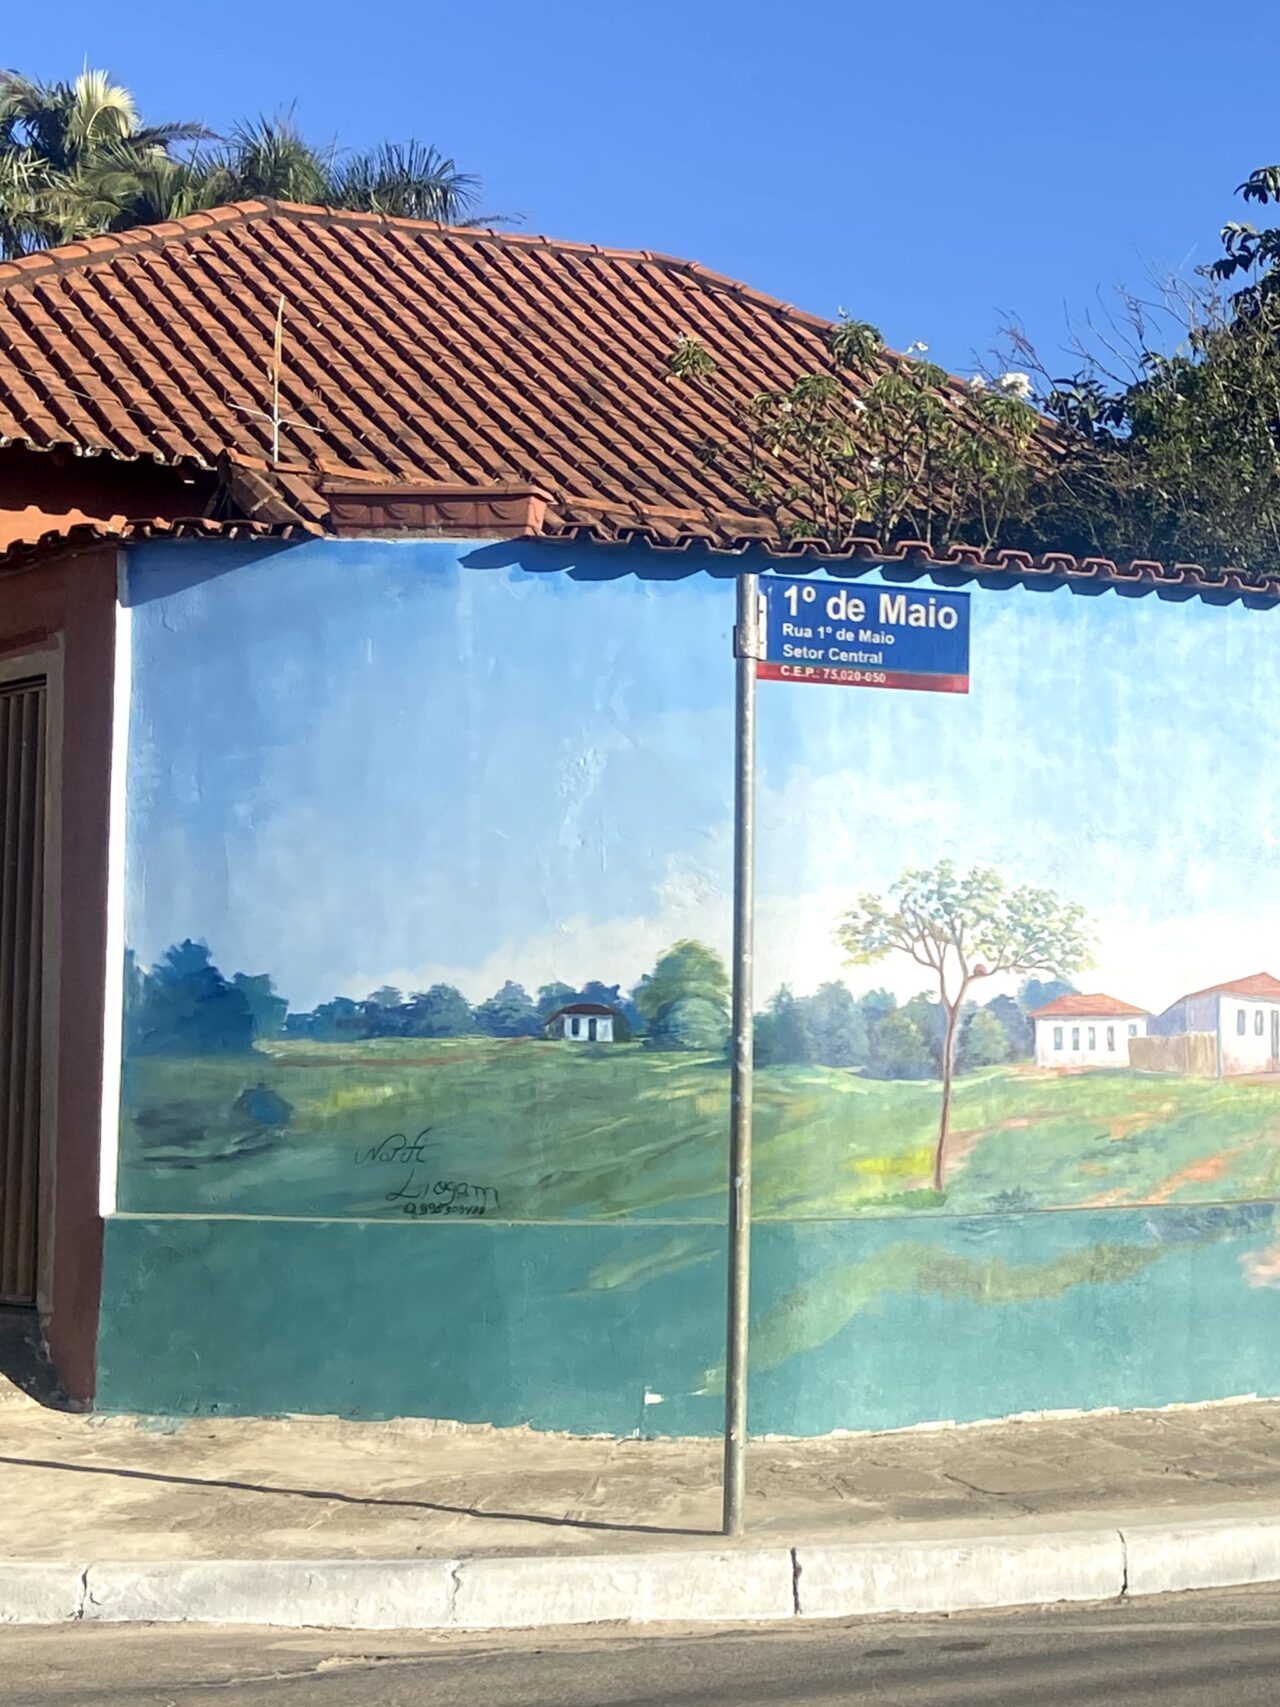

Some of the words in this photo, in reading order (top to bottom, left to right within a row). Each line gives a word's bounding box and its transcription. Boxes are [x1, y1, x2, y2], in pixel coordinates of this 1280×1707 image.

[783, 584, 816, 617] 1º
[826, 590, 866, 623] de
[878, 592, 959, 630] Maio
[782, 622, 813, 640] Rua
[836, 627, 855, 642] de
[858, 629, 895, 646] Maio
[782, 643, 825, 660] Setor
[828, 647, 883, 665] Central
[822, 668, 887, 684] 75.020-050
